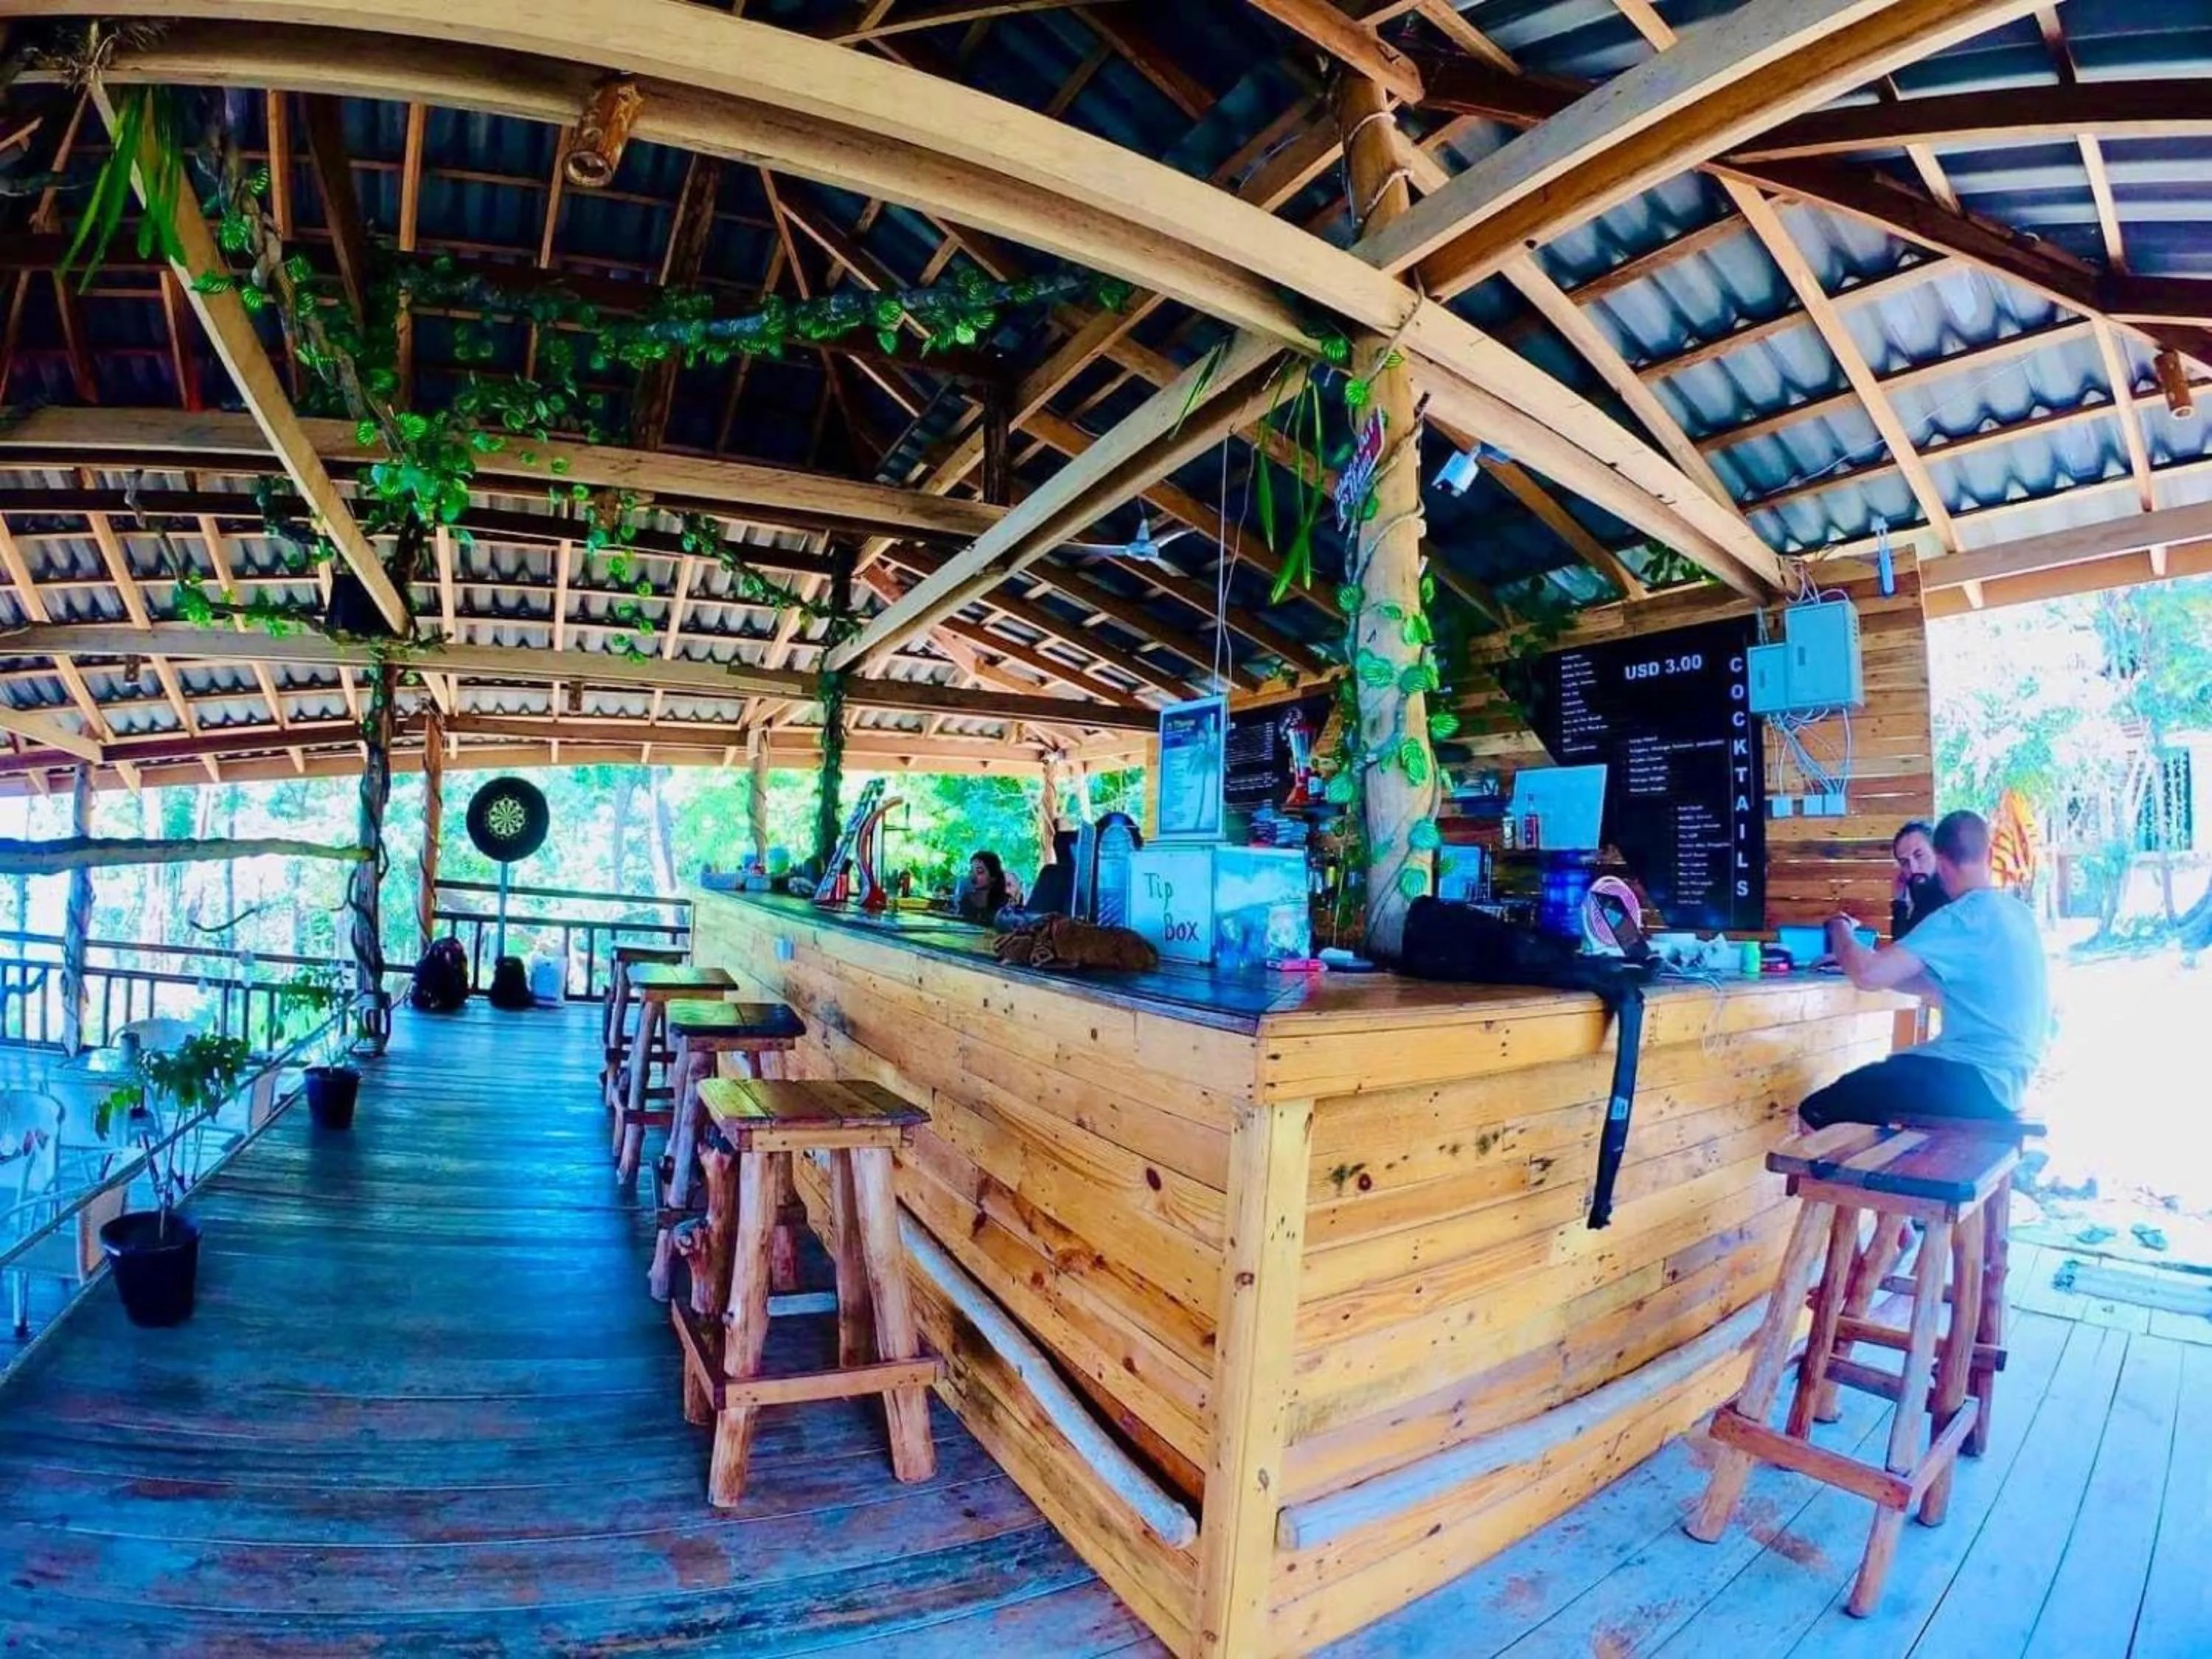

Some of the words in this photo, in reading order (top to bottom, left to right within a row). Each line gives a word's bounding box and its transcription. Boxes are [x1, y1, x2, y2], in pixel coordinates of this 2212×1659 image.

[1624, 661, 1659, 680] USD
[1665, 654, 1702, 674] 3.00
[1730, 657, 1749, 897] COCKTAILS
[1143, 872, 1173, 911] Tip
